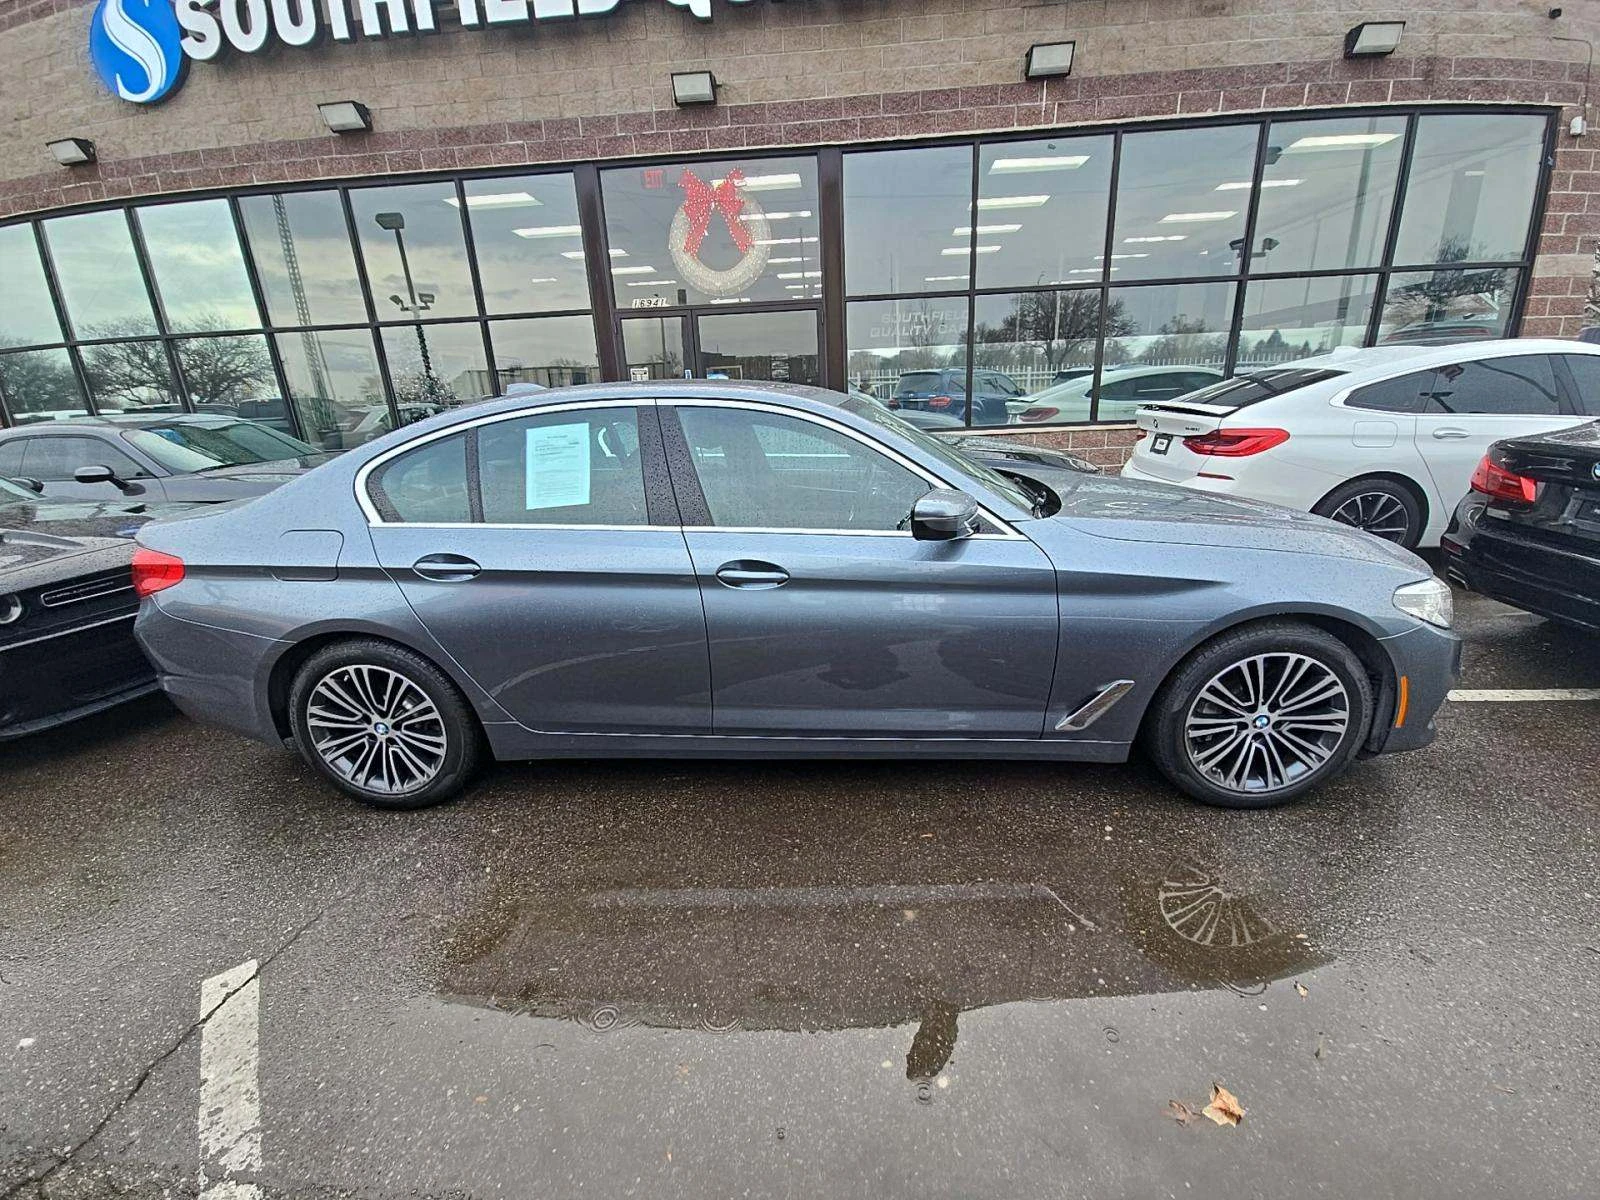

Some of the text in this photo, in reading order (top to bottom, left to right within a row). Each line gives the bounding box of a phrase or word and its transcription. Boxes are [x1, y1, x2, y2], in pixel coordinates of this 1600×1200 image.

[175, 0, 622, 60] SOUTH
[634, 298, 664, 308] 16941
[870, 324, 932, 338] QUALITY
